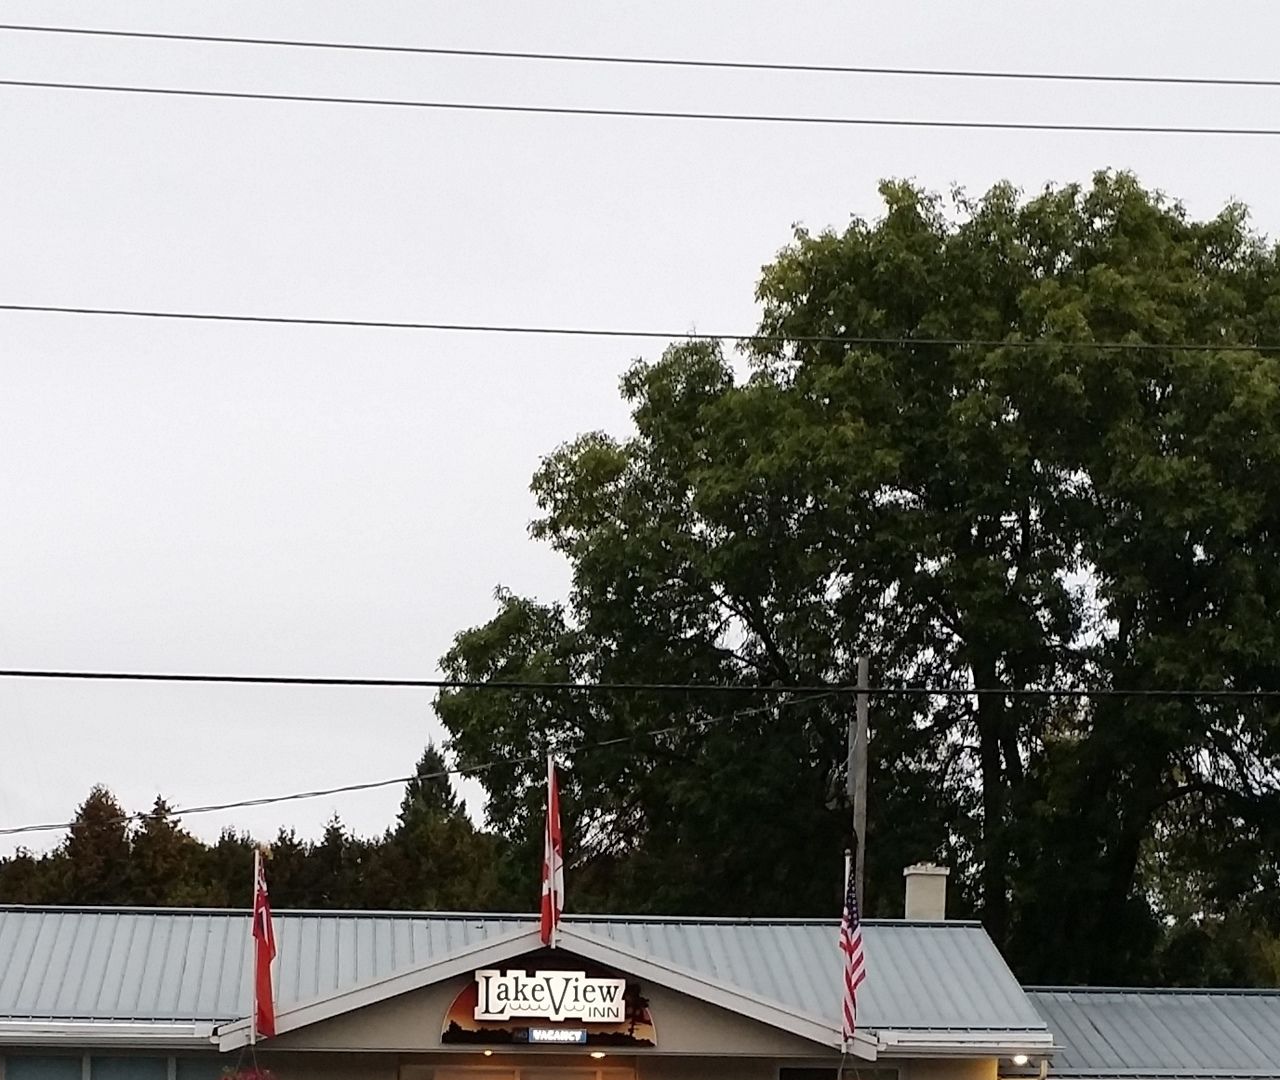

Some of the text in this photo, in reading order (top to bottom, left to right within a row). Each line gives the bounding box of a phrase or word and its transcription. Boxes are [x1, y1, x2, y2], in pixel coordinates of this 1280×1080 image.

[481, 976, 619, 1015] LakeView
[588, 1006, 619, 1018] INN
[532, 1029, 582, 1042] VACANCY
